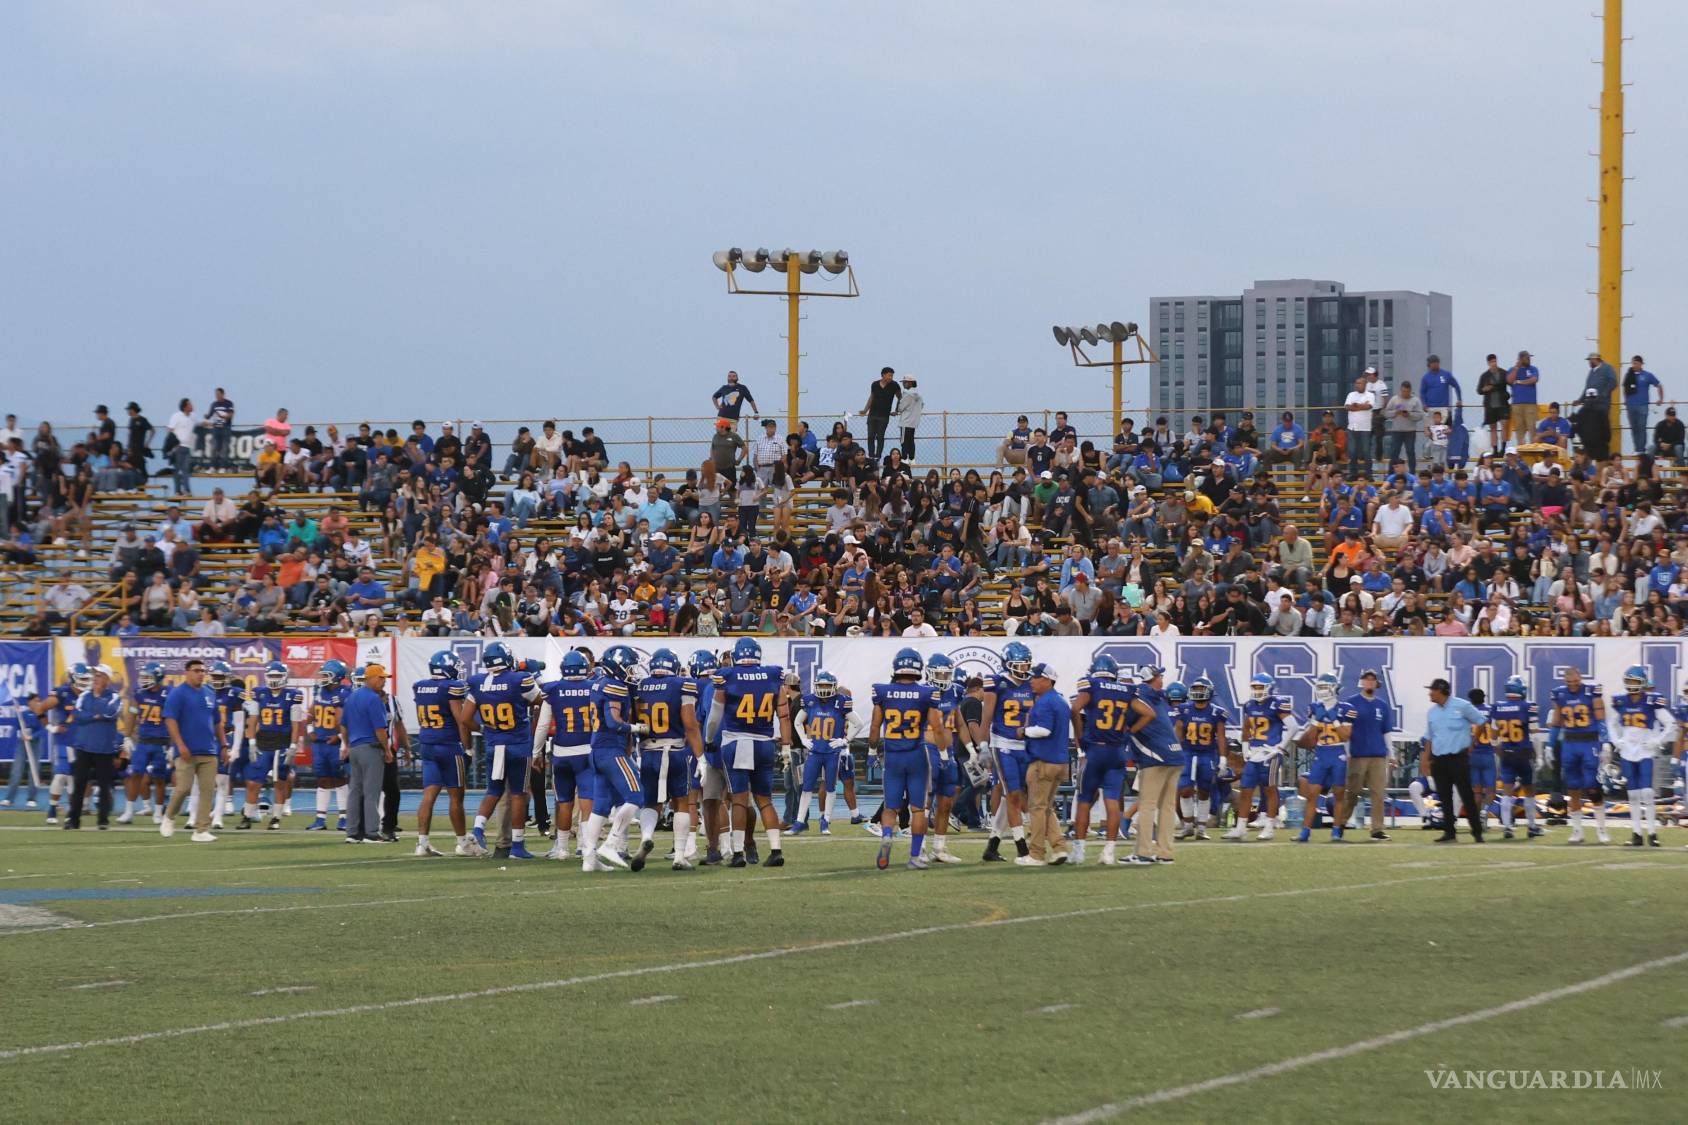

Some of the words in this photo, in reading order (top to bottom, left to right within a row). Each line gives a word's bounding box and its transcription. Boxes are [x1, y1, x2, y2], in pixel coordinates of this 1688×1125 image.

[771, 594, 779, 607] 8
[112, 647, 226, 658] ENTRENADOR
[479, 683, 508, 692] LBOS
[737, 672, 768, 681] LOBOS
[1099, 681, 1128, 693] LOBOS
[417, 686, 439, 694] LOBOS
[559, 689, 590, 697] LOBOS
[887, 690, 920, 699] LOBOS
[139, 704, 161, 726] 74
[261, 707, 284, 726] 91
[313, 704, 336, 730] 96
[417, 704, 445, 729] 45
[480, 702, 516, 730] 99
[637, 702, 670, 734] 50
[736, 692, 775, 725] 44
[1096, 699, 1129, 731] 37
[1561, 704, 1592, 728] 33
[810, 717, 836, 741] 40
[884, 708, 922, 740] 23
[1186, 721, 1214, 746] 49
[1498, 719, 1524, 743] 26
